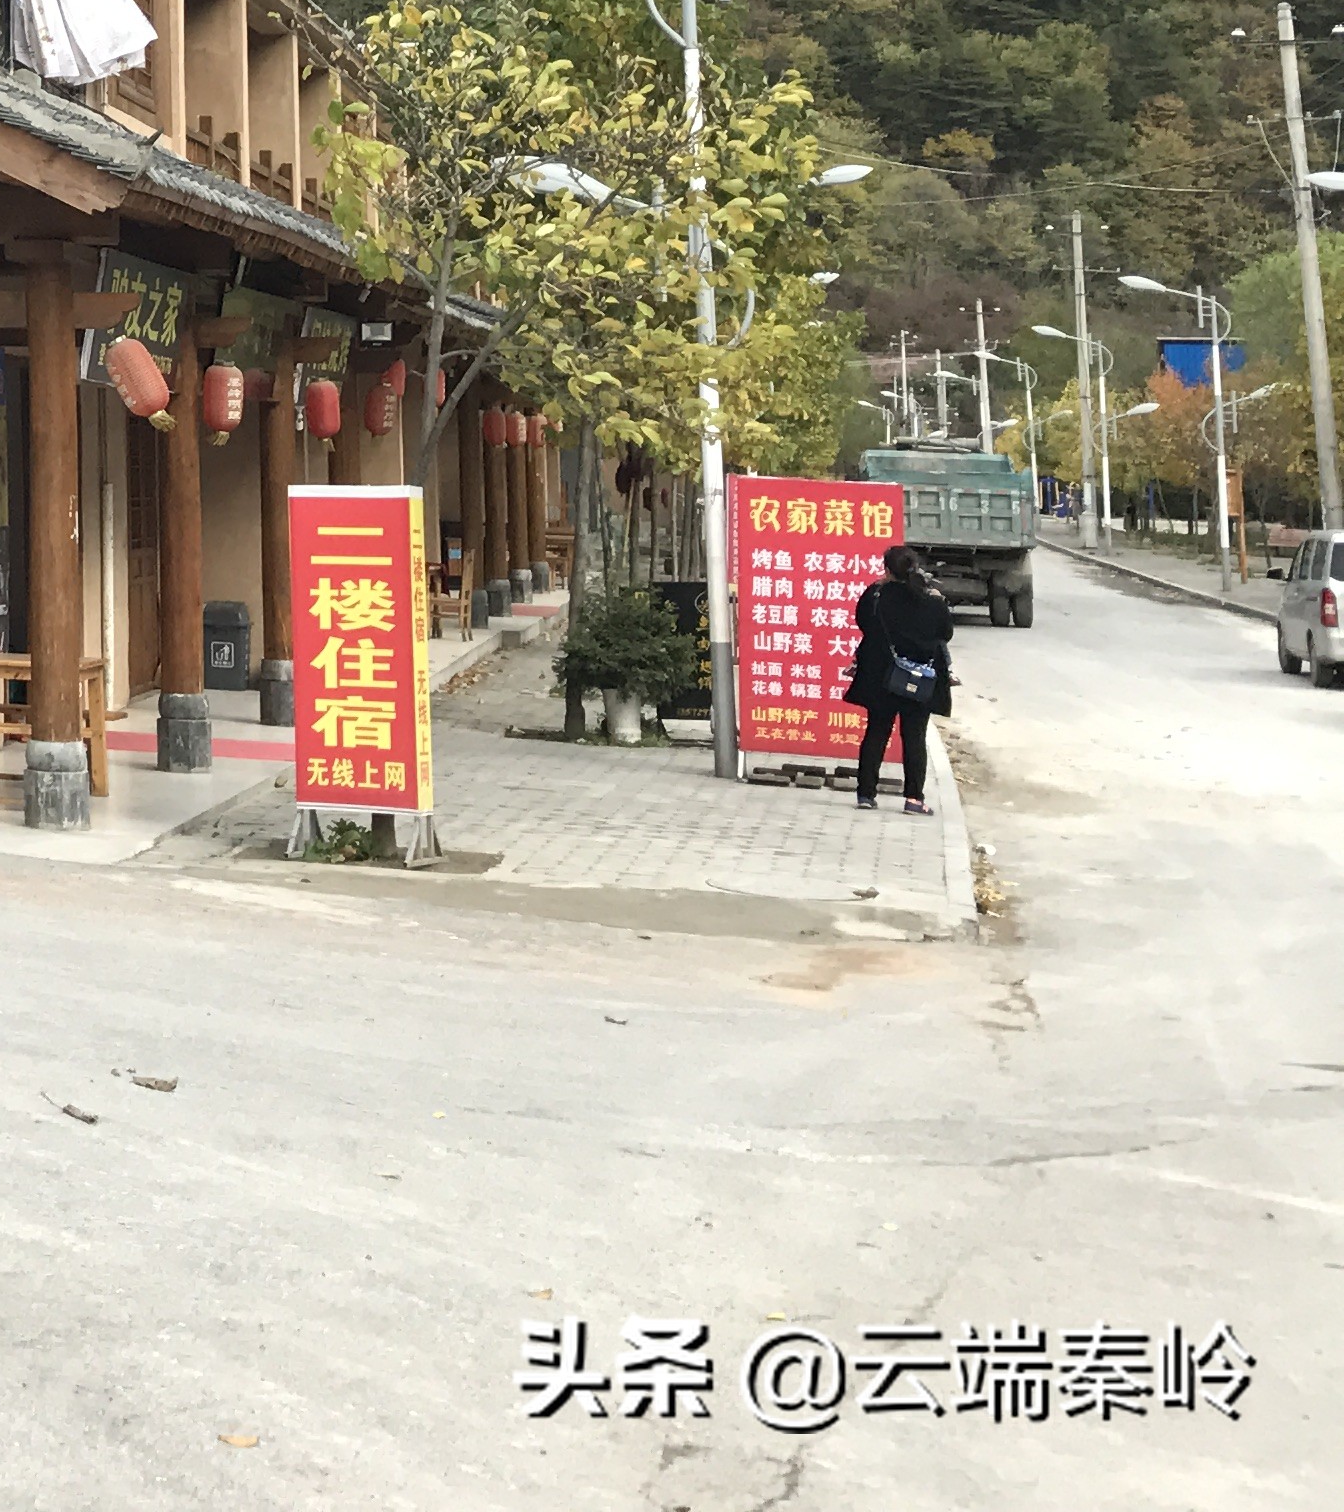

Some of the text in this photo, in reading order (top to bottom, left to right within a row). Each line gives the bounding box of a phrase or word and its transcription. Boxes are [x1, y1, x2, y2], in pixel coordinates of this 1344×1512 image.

[749, 496, 894, 539] 农家菜馆
[751, 548, 886, 576] 烤鱼 农家小炒
[751, 576, 794, 599] 腊肉
[751, 603, 799, 627] 老豆腐
[309, 526, 398, 751] 二楼住宿
[753, 630, 813, 655] 山野菜
[751, 660, 783, 678] 扯面
[790, 663, 823, 680] 米饭
[751, 680, 783, 697] 花卷
[751, 706, 819, 726] 山野特产
[754, 726, 817, 743] 正在营业
[306, 756, 407, 792] 无线上网
